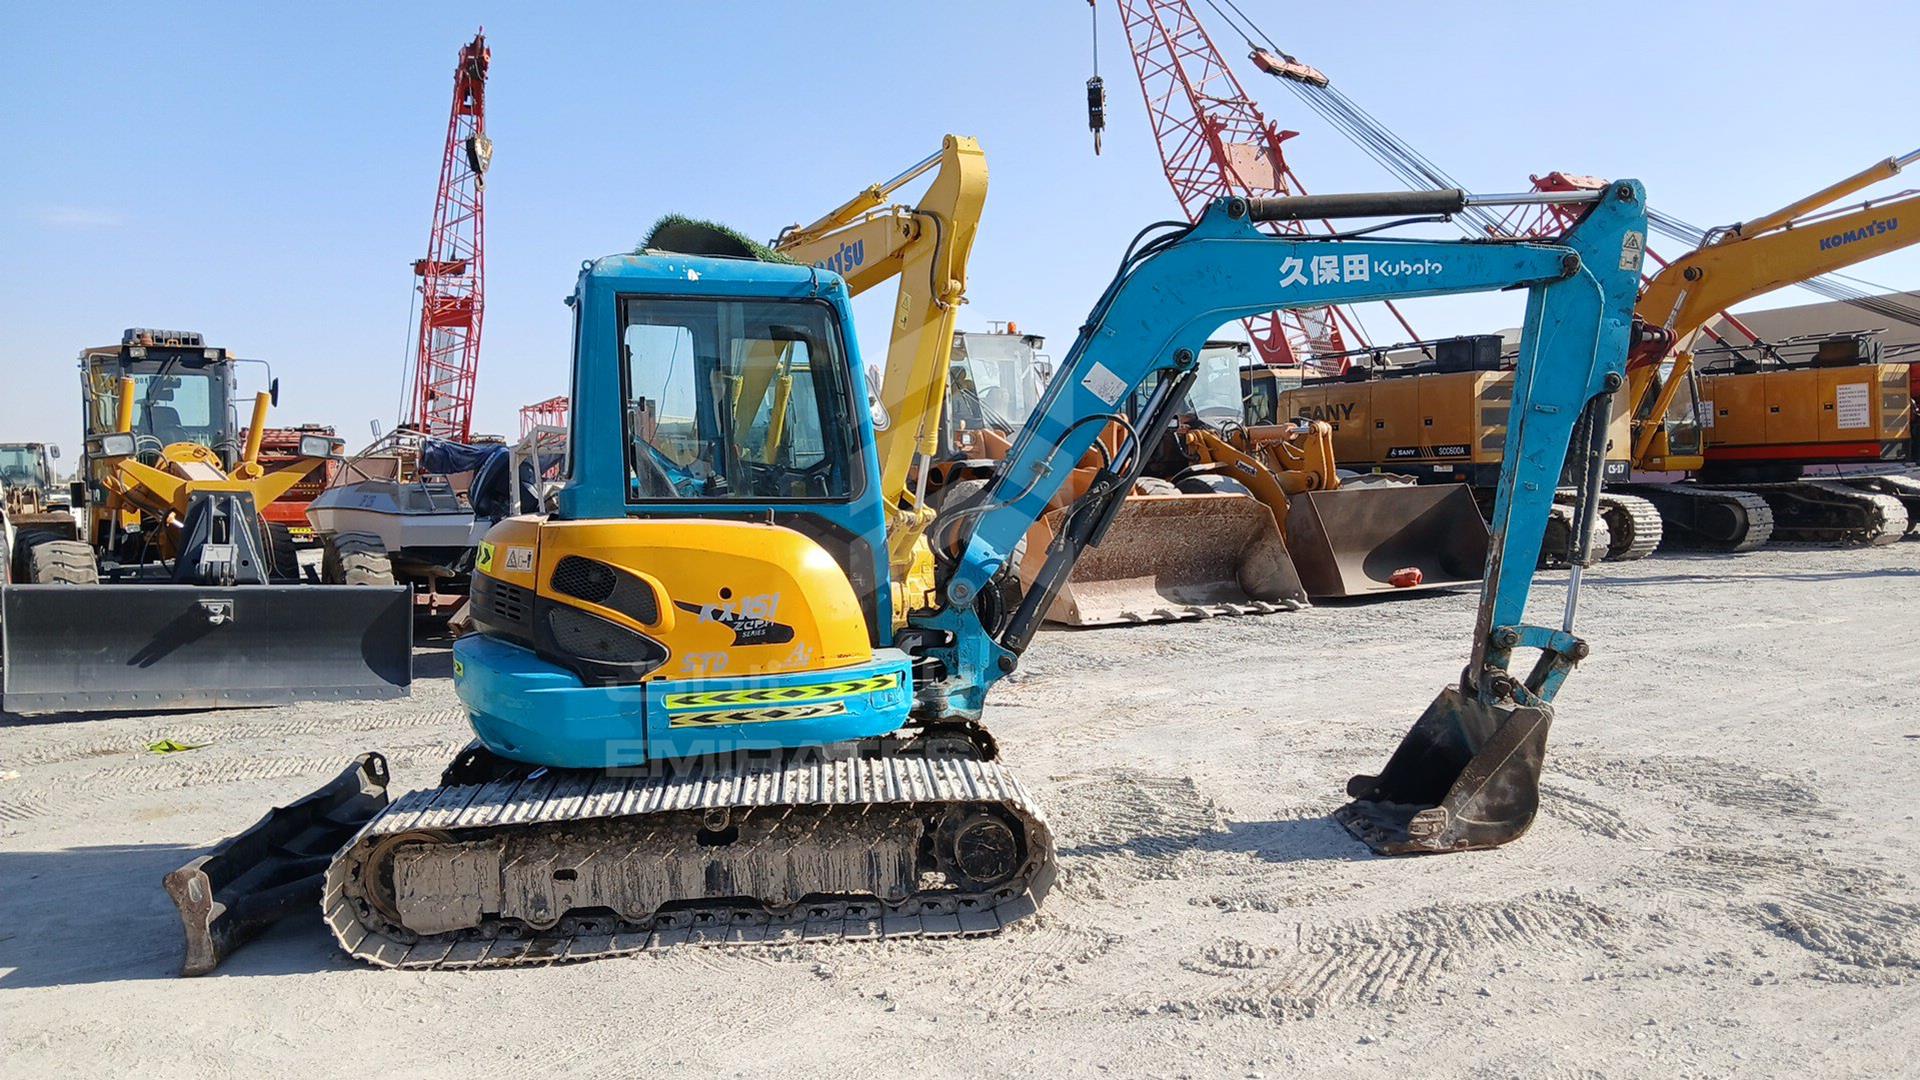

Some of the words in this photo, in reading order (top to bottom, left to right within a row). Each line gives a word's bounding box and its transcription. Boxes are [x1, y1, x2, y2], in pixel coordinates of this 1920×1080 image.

[1819, 217, 1898, 251] KOMATSU
[815, 239, 864, 275] ATSU
[1279, 253, 1370, 288] 久保田
[1374, 259, 1443, 277] Kubota
[1298, 403, 1355, 420] SANY
